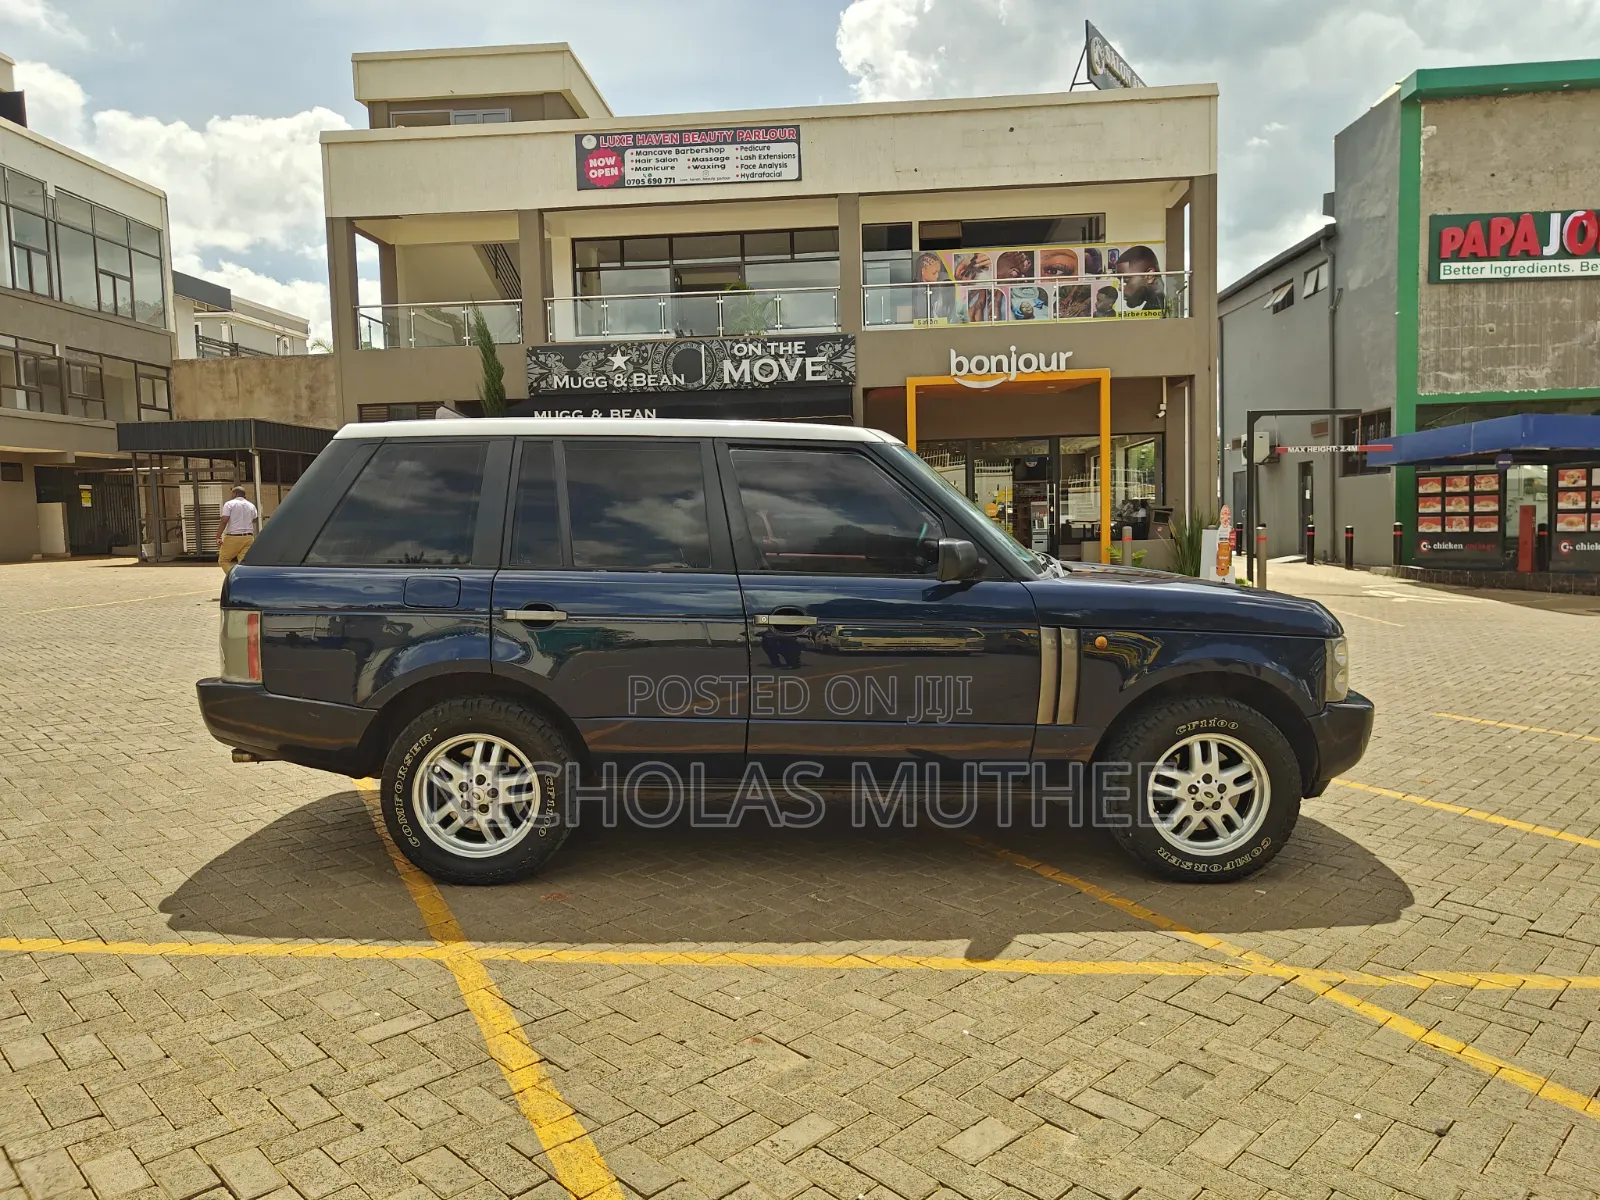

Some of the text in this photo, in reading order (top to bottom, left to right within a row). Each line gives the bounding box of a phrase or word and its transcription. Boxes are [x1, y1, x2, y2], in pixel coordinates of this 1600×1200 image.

[600, 128, 797, 148] LUXE HAVEN BEAUTY PARLOUR
[675, 147, 725, 155] Barbershop
[759, 152, 796, 160] Extensions
[589, 156, 616, 167] NOW
[758, 161, 788, 169] Analysis
[589, 167, 618, 178] OPEN
[740, 171, 783, 179] Hydrafacial
[1440, 209, 1600, 259] PAPA JO
[1442, 264, 1485, 276] Better
[1489, 261, 1575, 277] Ingredients.
[734, 340, 806, 355] ON THE
[723, 355, 828, 384] MOVE
[950, 345, 1073, 381] bonjour
[613, 373, 628, 388] &
[591, 409, 603, 418] &
[1307, 445, 1338, 453] HEIGHT:
[394, 733, 433, 848] COMFORSER
[1157, 836, 1272, 873] COMFORSER
